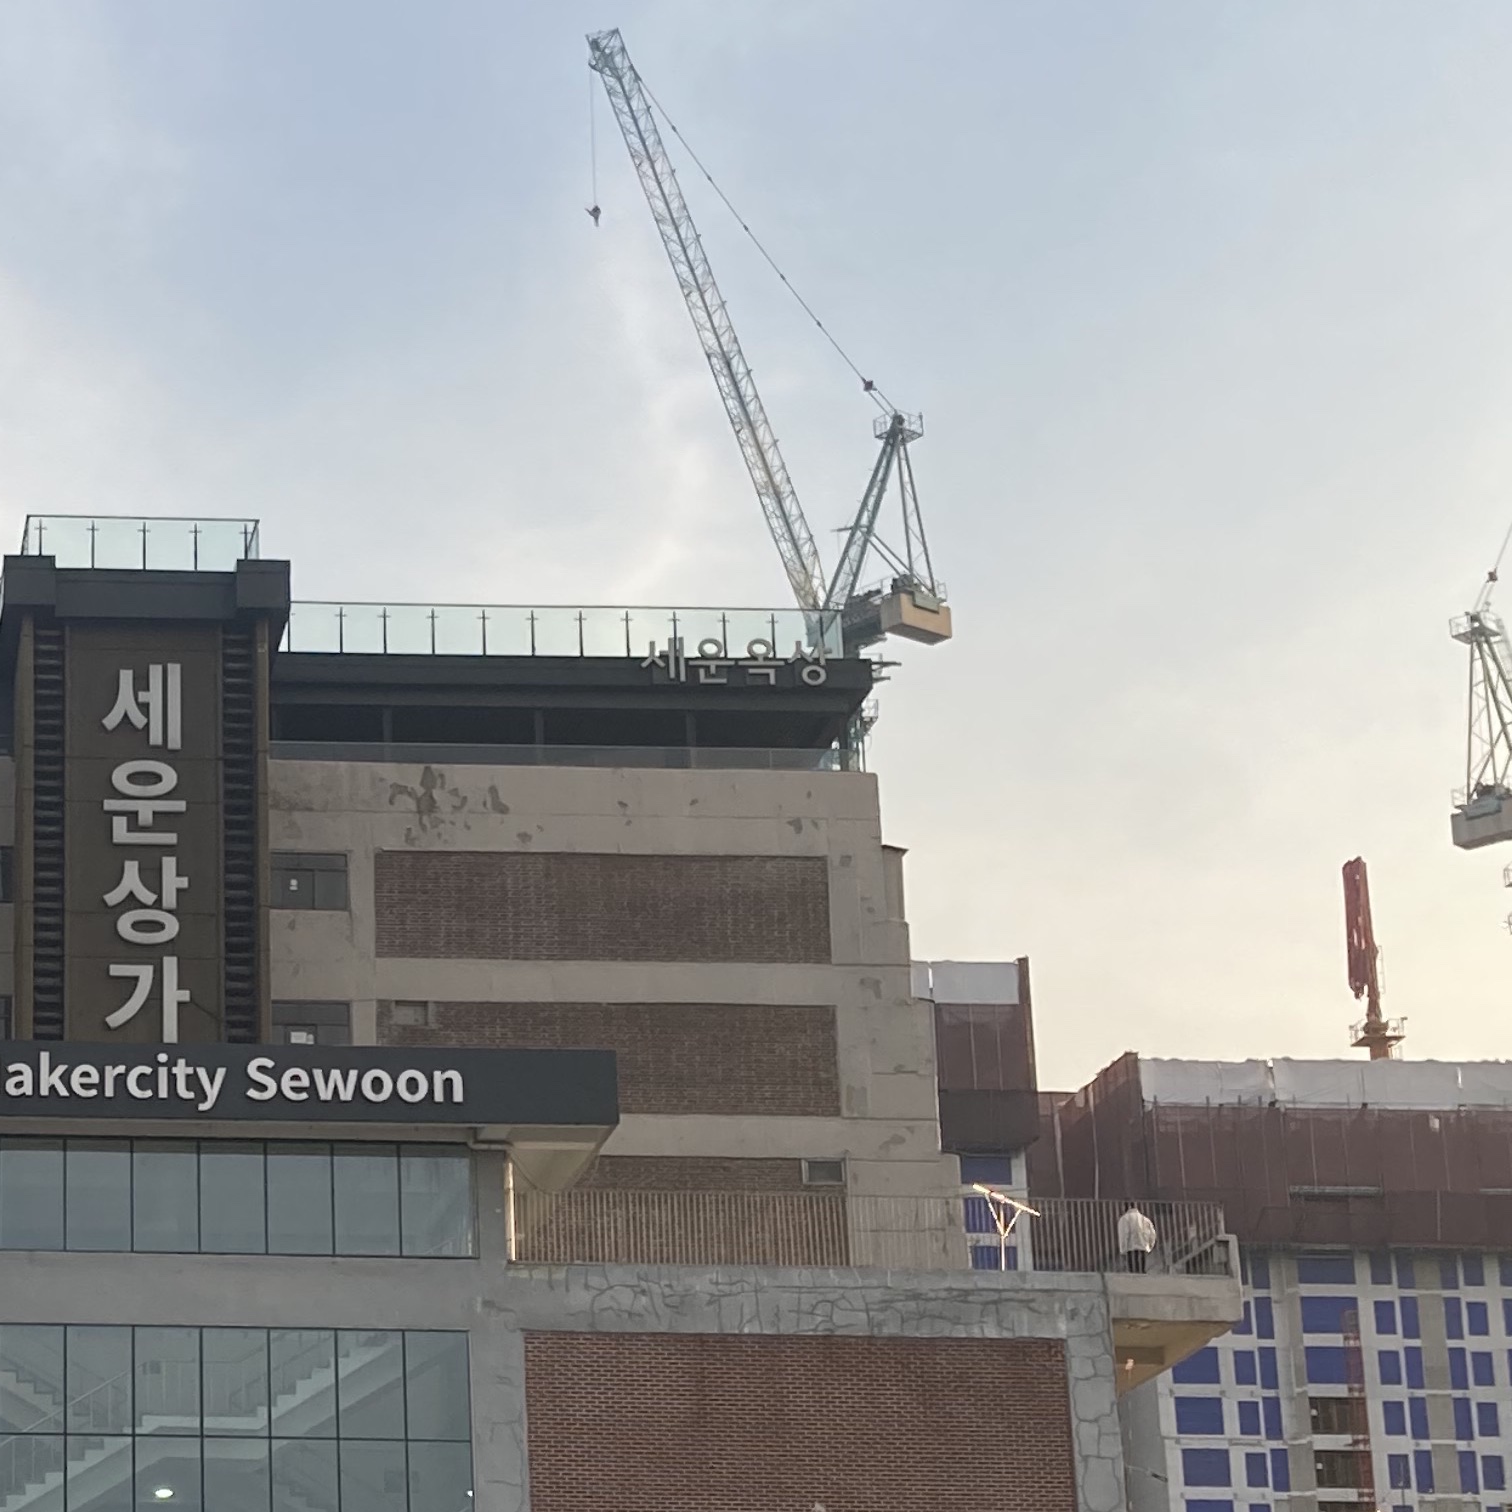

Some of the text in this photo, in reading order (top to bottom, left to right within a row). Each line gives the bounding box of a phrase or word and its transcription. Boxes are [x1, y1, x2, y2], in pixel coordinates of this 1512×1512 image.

[640, 636, 833, 687] 세운옥상
[101, 663, 191, 1044] 세운상가
[245, 1057, 464, 1104] Sewoon
